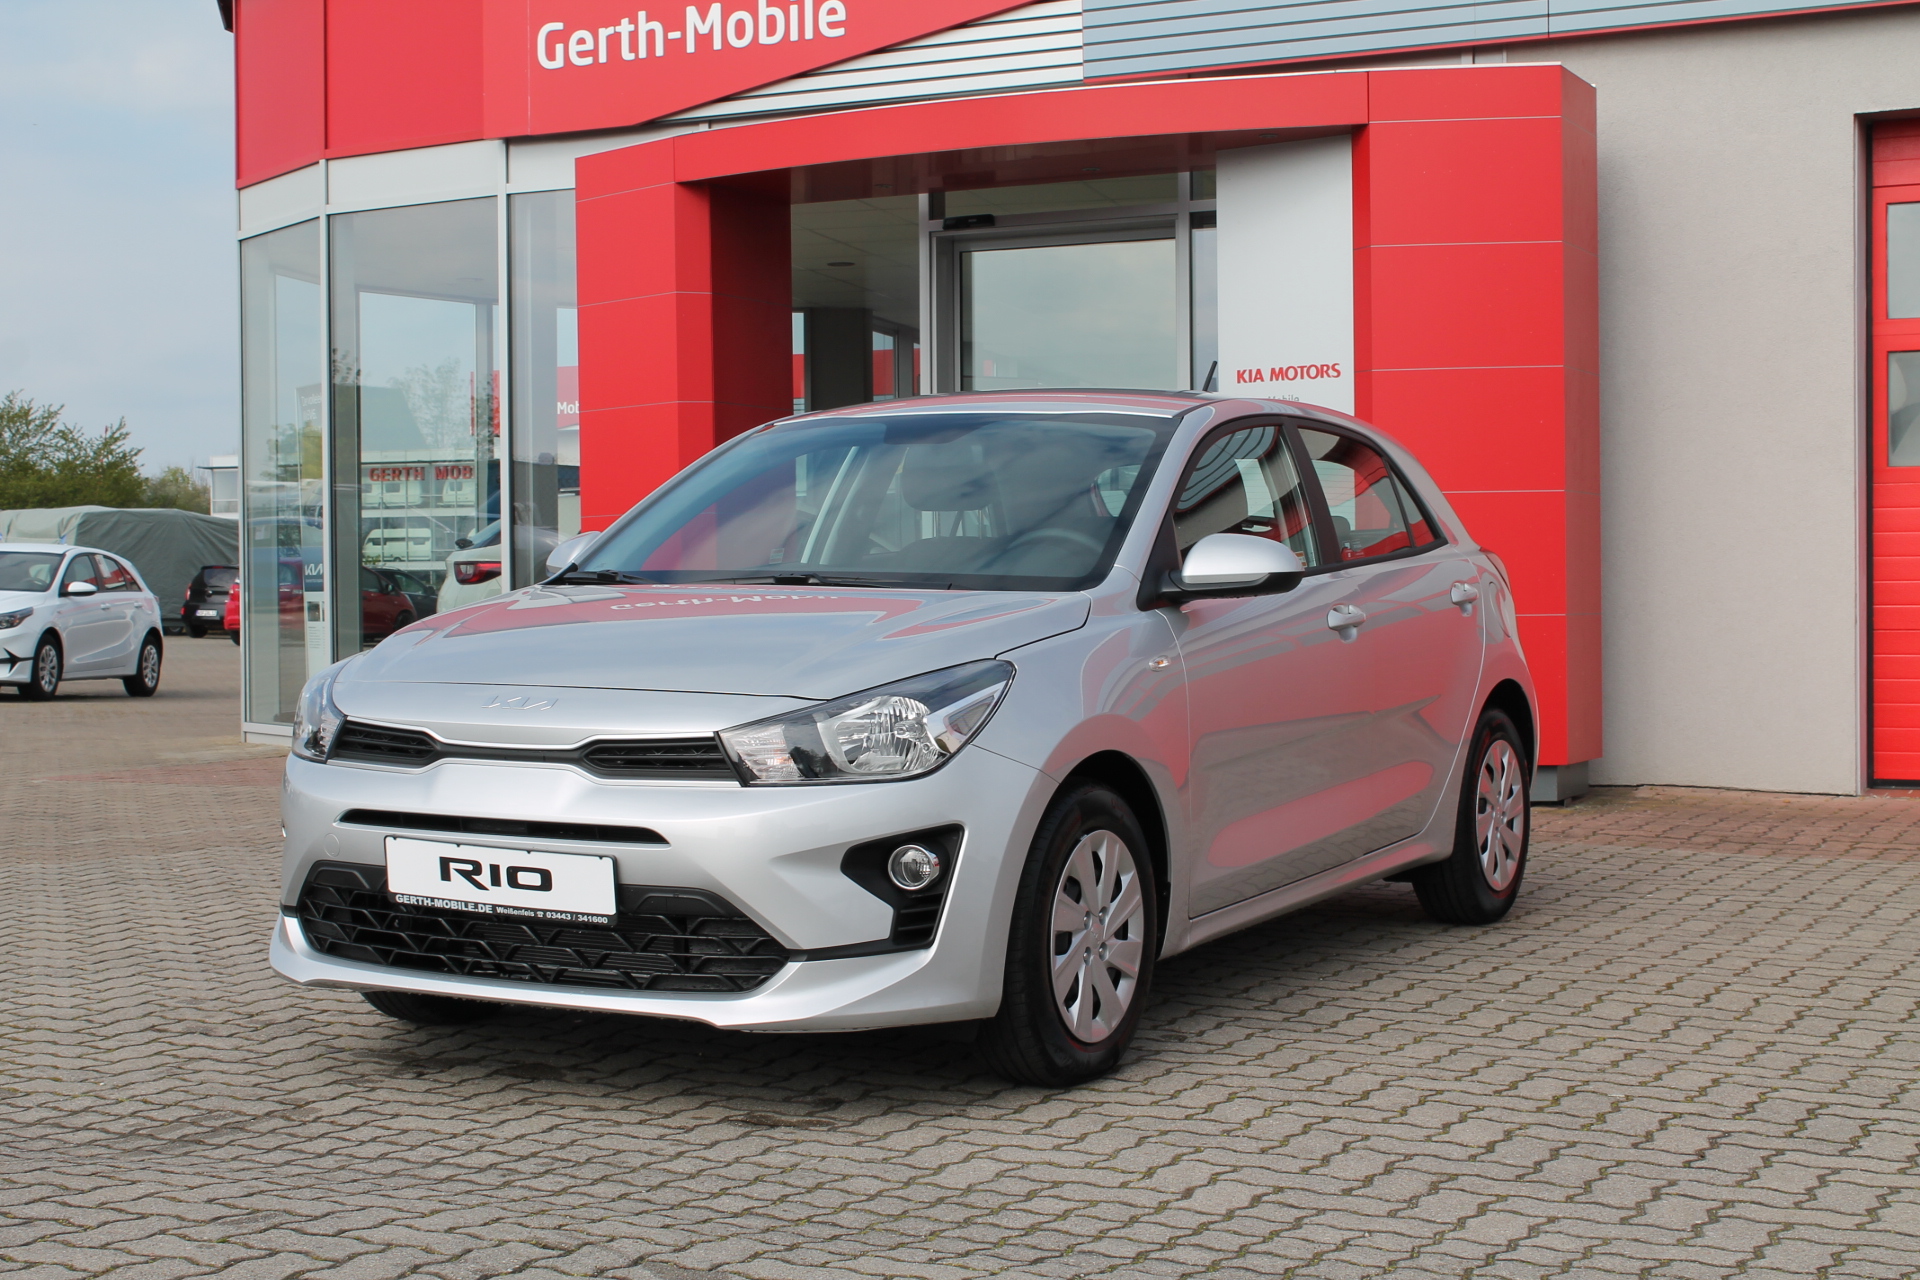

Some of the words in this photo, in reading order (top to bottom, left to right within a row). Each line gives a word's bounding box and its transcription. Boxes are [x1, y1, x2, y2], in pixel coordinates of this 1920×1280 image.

[537, 0, 846, 69] Gerth-Mobile
[1236, 368, 1265, 384] KIA
[1269, 363, 1341, 382] MOTORS
[369, 467, 425, 481] GERTH
[434, 465, 473, 480] MOB
[439, 856, 552, 892] RIO
[395, 894, 493, 914] GERTH-MOBILE.DE
[496, 906, 535, 917] Weißenfels
[546, 911, 571, 920] 03443
[577, 914, 608, 924] 341600
